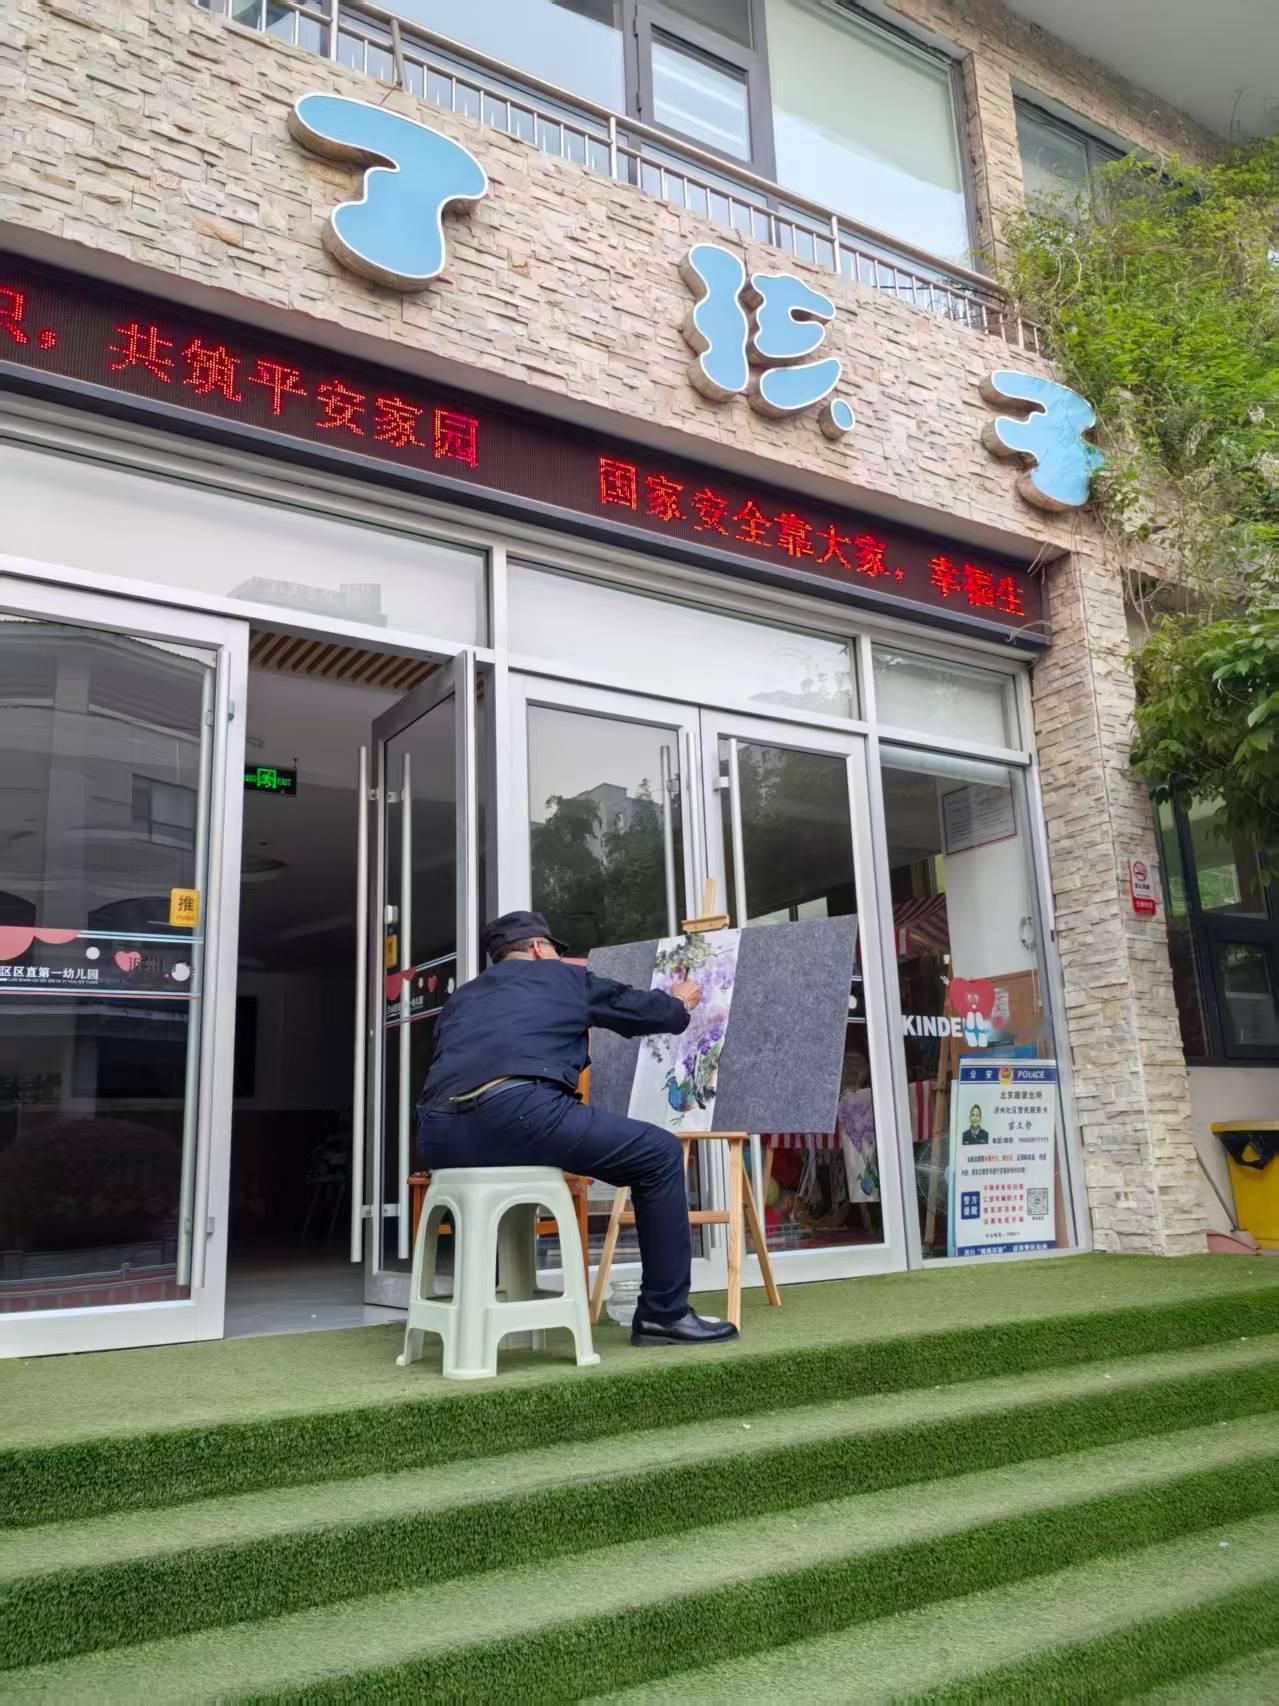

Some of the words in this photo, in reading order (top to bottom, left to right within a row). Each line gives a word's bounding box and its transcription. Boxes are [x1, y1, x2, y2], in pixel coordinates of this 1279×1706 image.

[178, 895, 193, 912] 推
[902, 1015, 966, 1037] KINDE
[1017, 1070, 1045, 1079] POLICE
